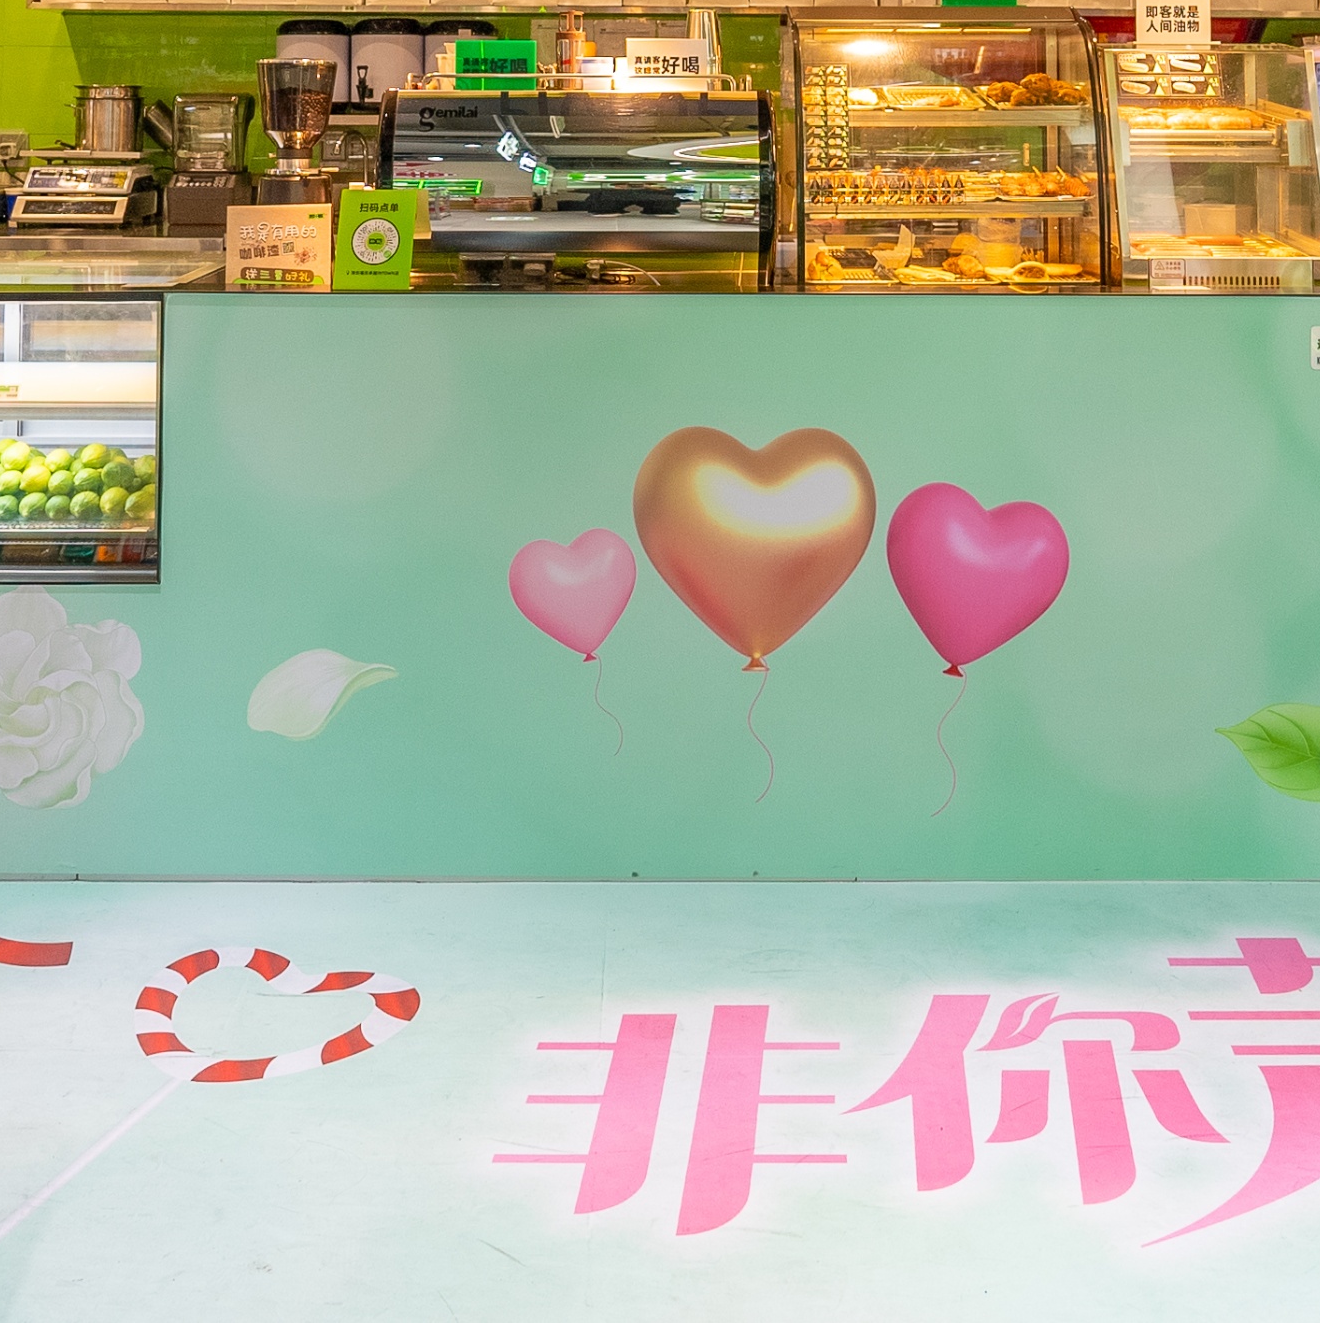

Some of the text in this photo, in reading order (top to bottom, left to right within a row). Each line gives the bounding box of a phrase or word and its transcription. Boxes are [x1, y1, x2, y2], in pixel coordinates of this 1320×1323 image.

[1145, 3, 1200, 20] 即客就是
[1145, 20, 1201, 35] 人间油物
[661, 56, 700, 75] 好喝
[418, 105, 479, 132] gemilai
[359, 202, 400, 213] 扫码点单
[239, 222, 318, 242] 我是有用的
